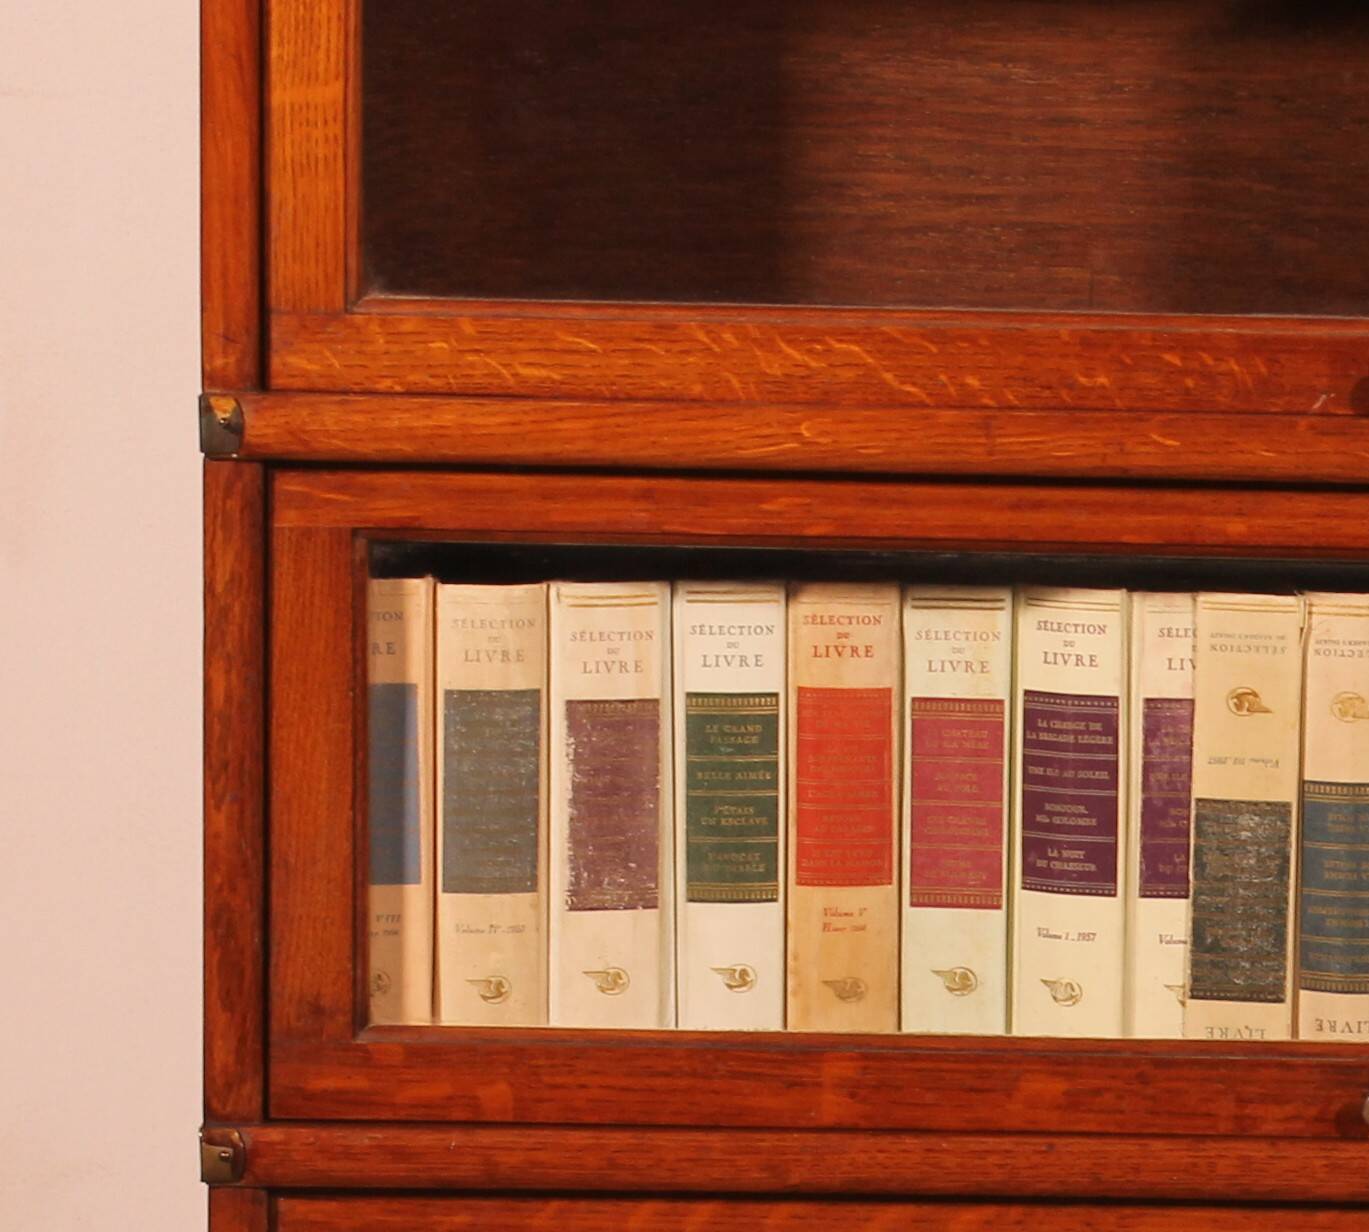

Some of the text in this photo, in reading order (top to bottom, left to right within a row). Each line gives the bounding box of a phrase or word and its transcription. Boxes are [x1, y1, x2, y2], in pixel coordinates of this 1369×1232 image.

[802, 614, 883, 626] SÉLECTION
[1036, 619, 1107, 636] SÉLECTION
[569, 629, 654, 643] SÉLECTION
[689, 623, 776, 636] SÉLECTION
[915, 627, 1001, 642] SÉLECTION
[464, 649, 525, 664] LIVRE
[811, 645, 875, 659] LIVRE
[1042, 650, 1099, 669] LIVRE
[582, 660, 644, 675] LIVRE
[701, 654, 765, 669] LIVRE
[927, 659, 992, 674] LIVRE
